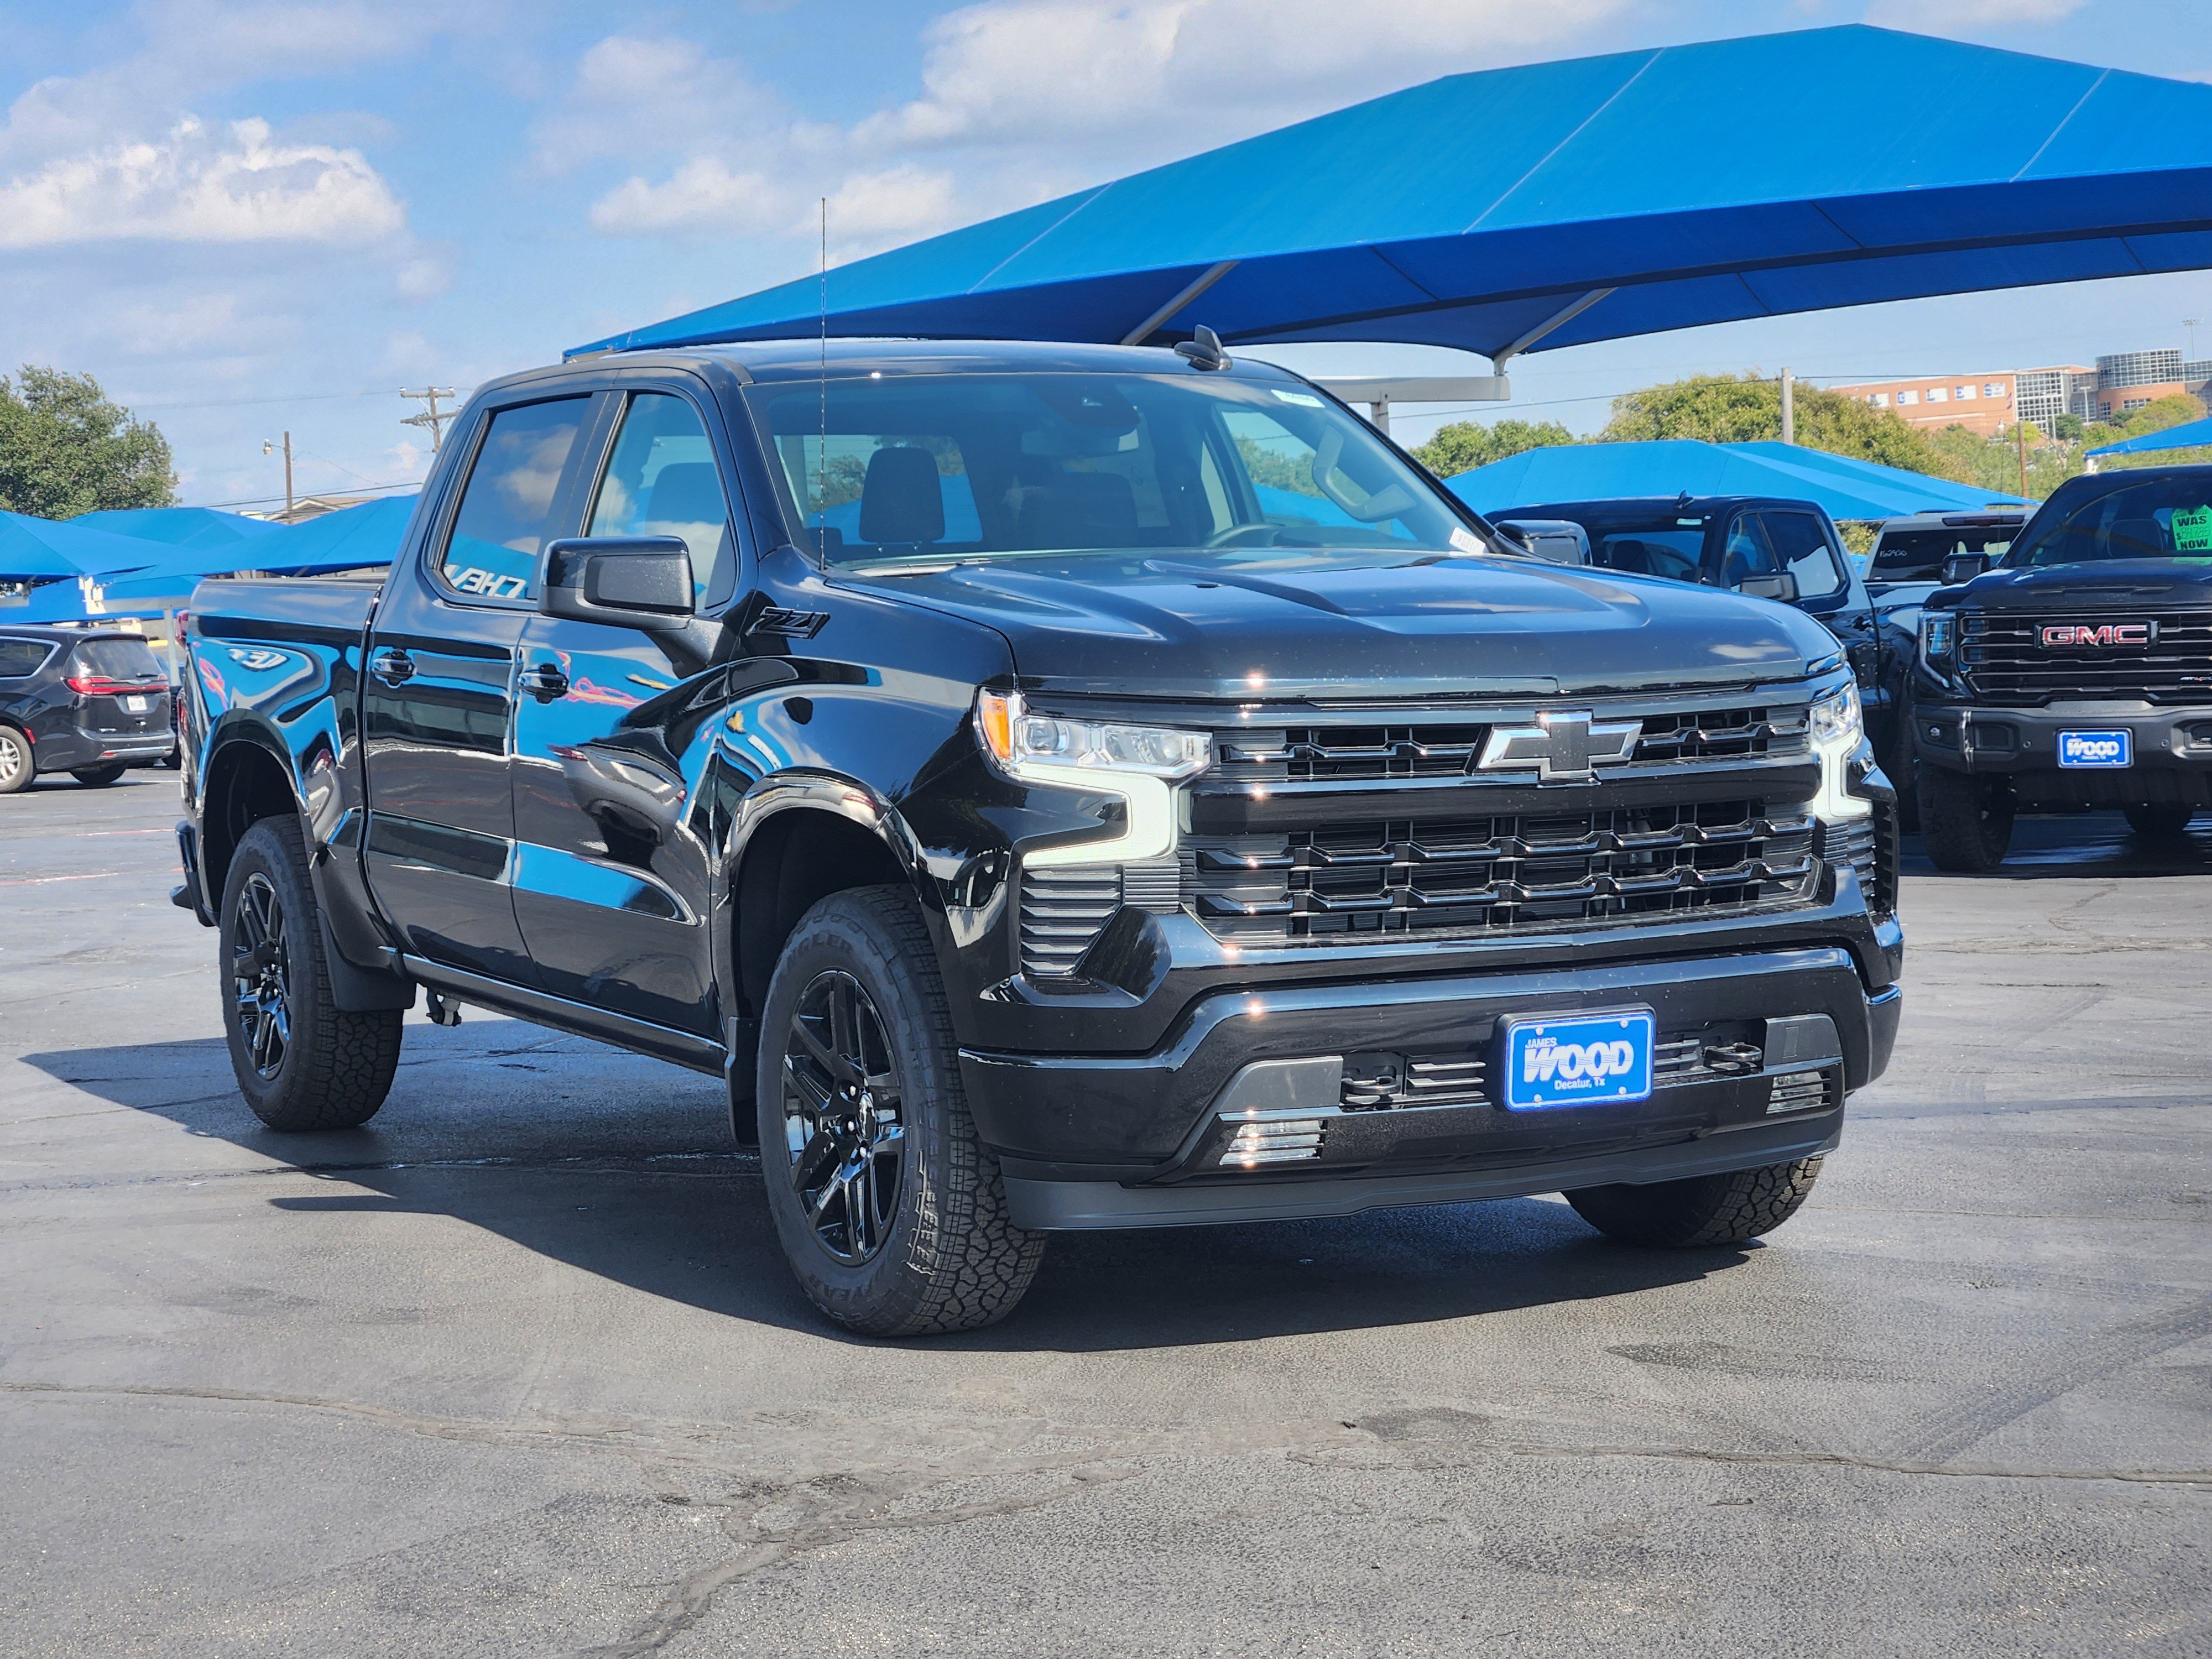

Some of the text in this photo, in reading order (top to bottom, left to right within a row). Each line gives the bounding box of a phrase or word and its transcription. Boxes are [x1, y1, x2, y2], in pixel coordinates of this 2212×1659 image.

[2177, 515, 2207, 527] WAS
[2180, 539, 2208, 550] NOW
[2043, 625, 2148, 645] GMC
[2067, 741, 2120, 756] WOOD
[1525, 1037, 1557, 1048] JAMES
[1524, 1040, 1634, 1082] WOOD
[1554, 1078, 1593, 1090] Decatur,
